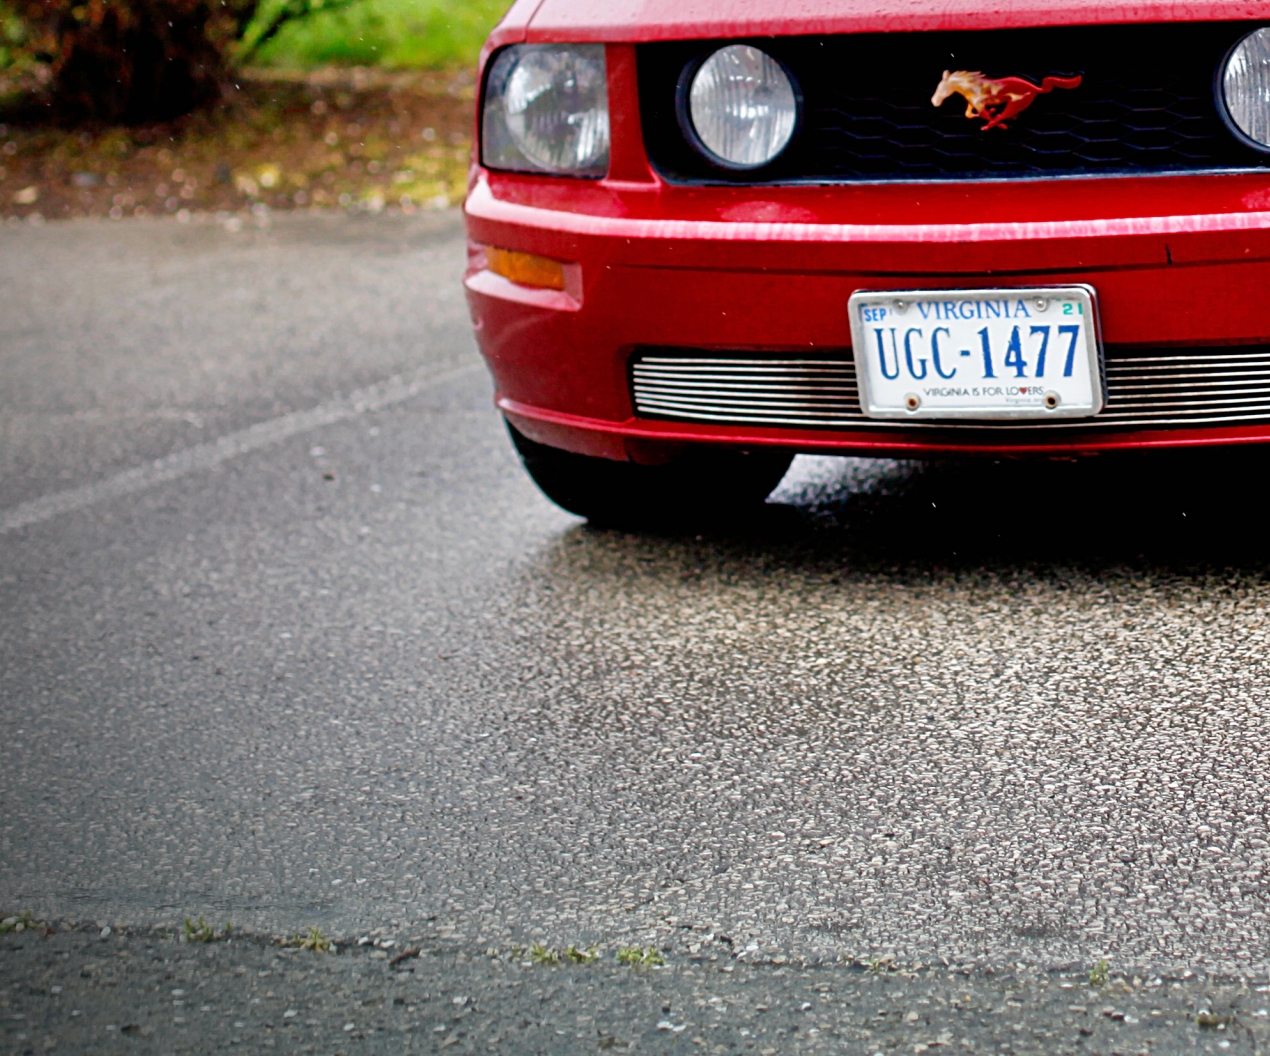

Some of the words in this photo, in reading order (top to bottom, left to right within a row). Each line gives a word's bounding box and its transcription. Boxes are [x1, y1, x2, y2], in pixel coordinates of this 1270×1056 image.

[864, 308, 887, 322] SEP
[916, 300, 1032, 320] VIRGINIA
[874, 325, 1080, 380] UGC-1477
[923, 387, 970, 397] VIRGINIA
[972, 387, 980, 396] IS
[983, 387, 1003, 396] FOR
